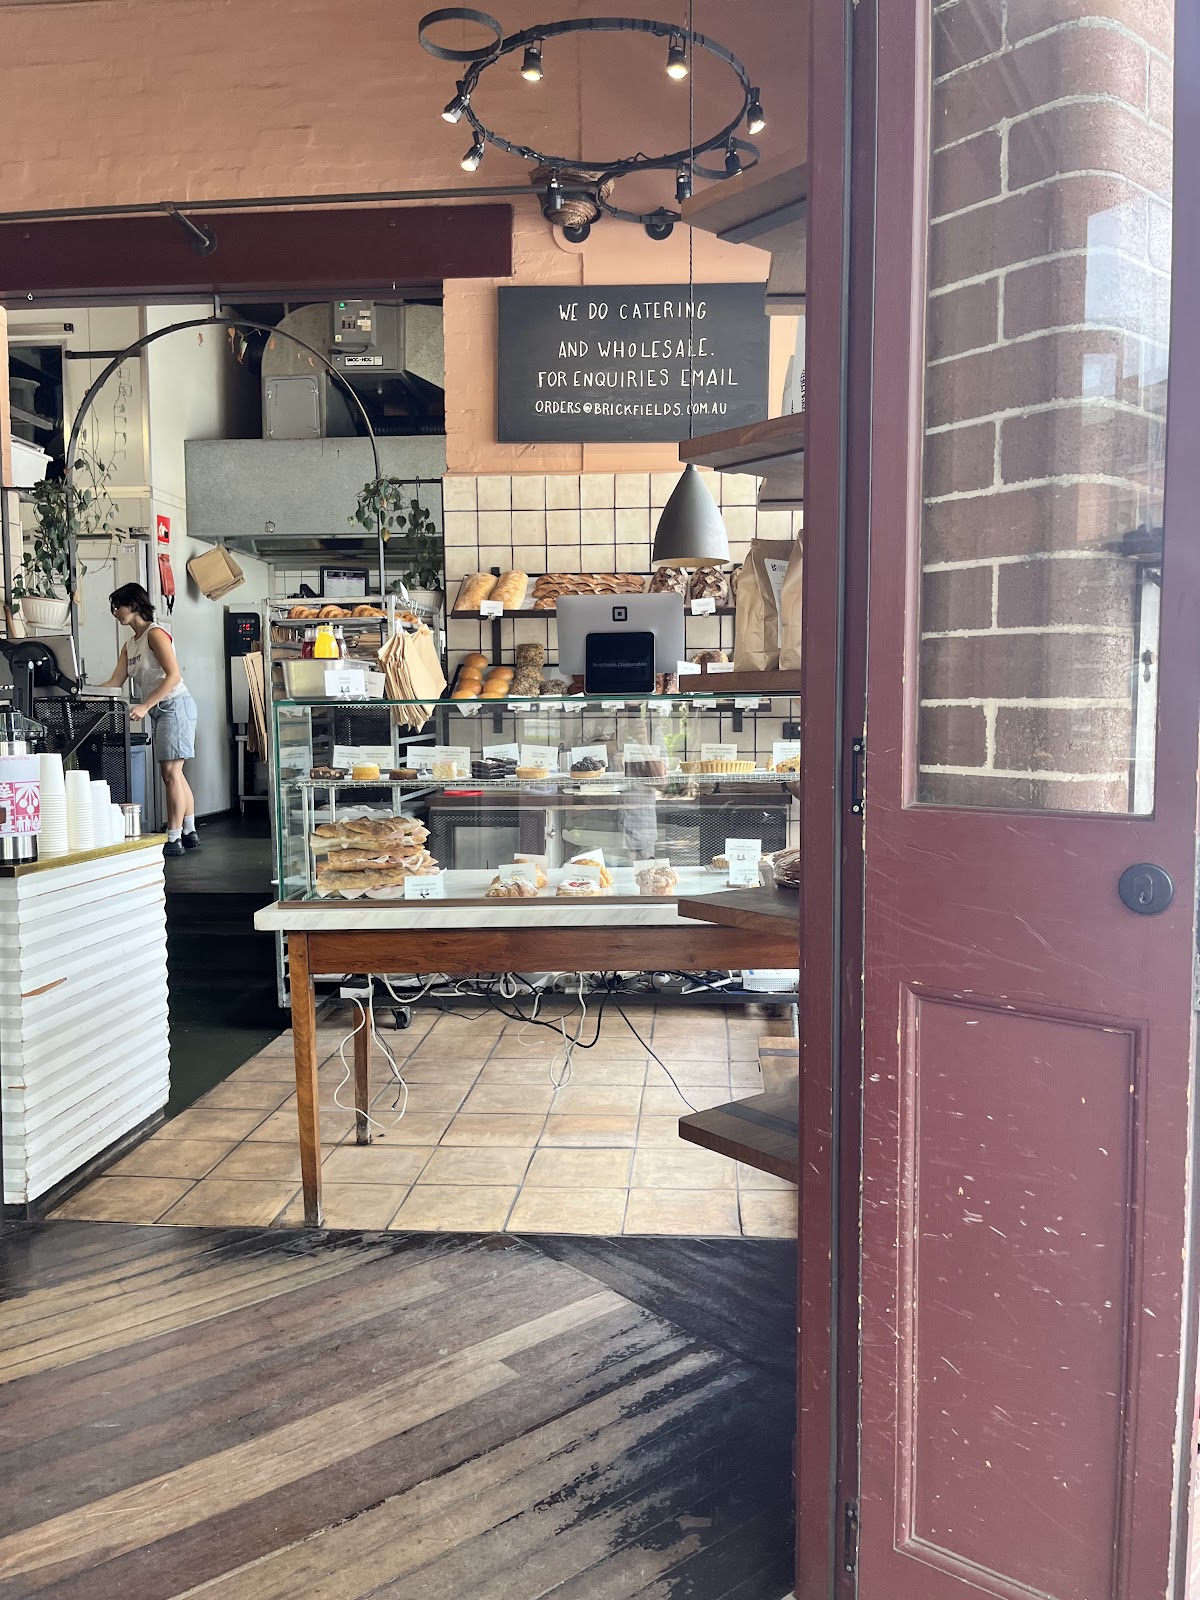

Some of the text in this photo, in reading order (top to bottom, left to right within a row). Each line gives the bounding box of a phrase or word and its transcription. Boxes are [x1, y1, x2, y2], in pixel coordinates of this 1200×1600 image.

[558, 301, 707, 321] WE DO CATERING
[558, 337, 715, 359] AND WHOLESALE.
[538, 368, 738, 388] FOR ENQUIRIES EMAIL
[535, 400, 727, 416] ORDERS@BRICKFIELDS.COM.AU
